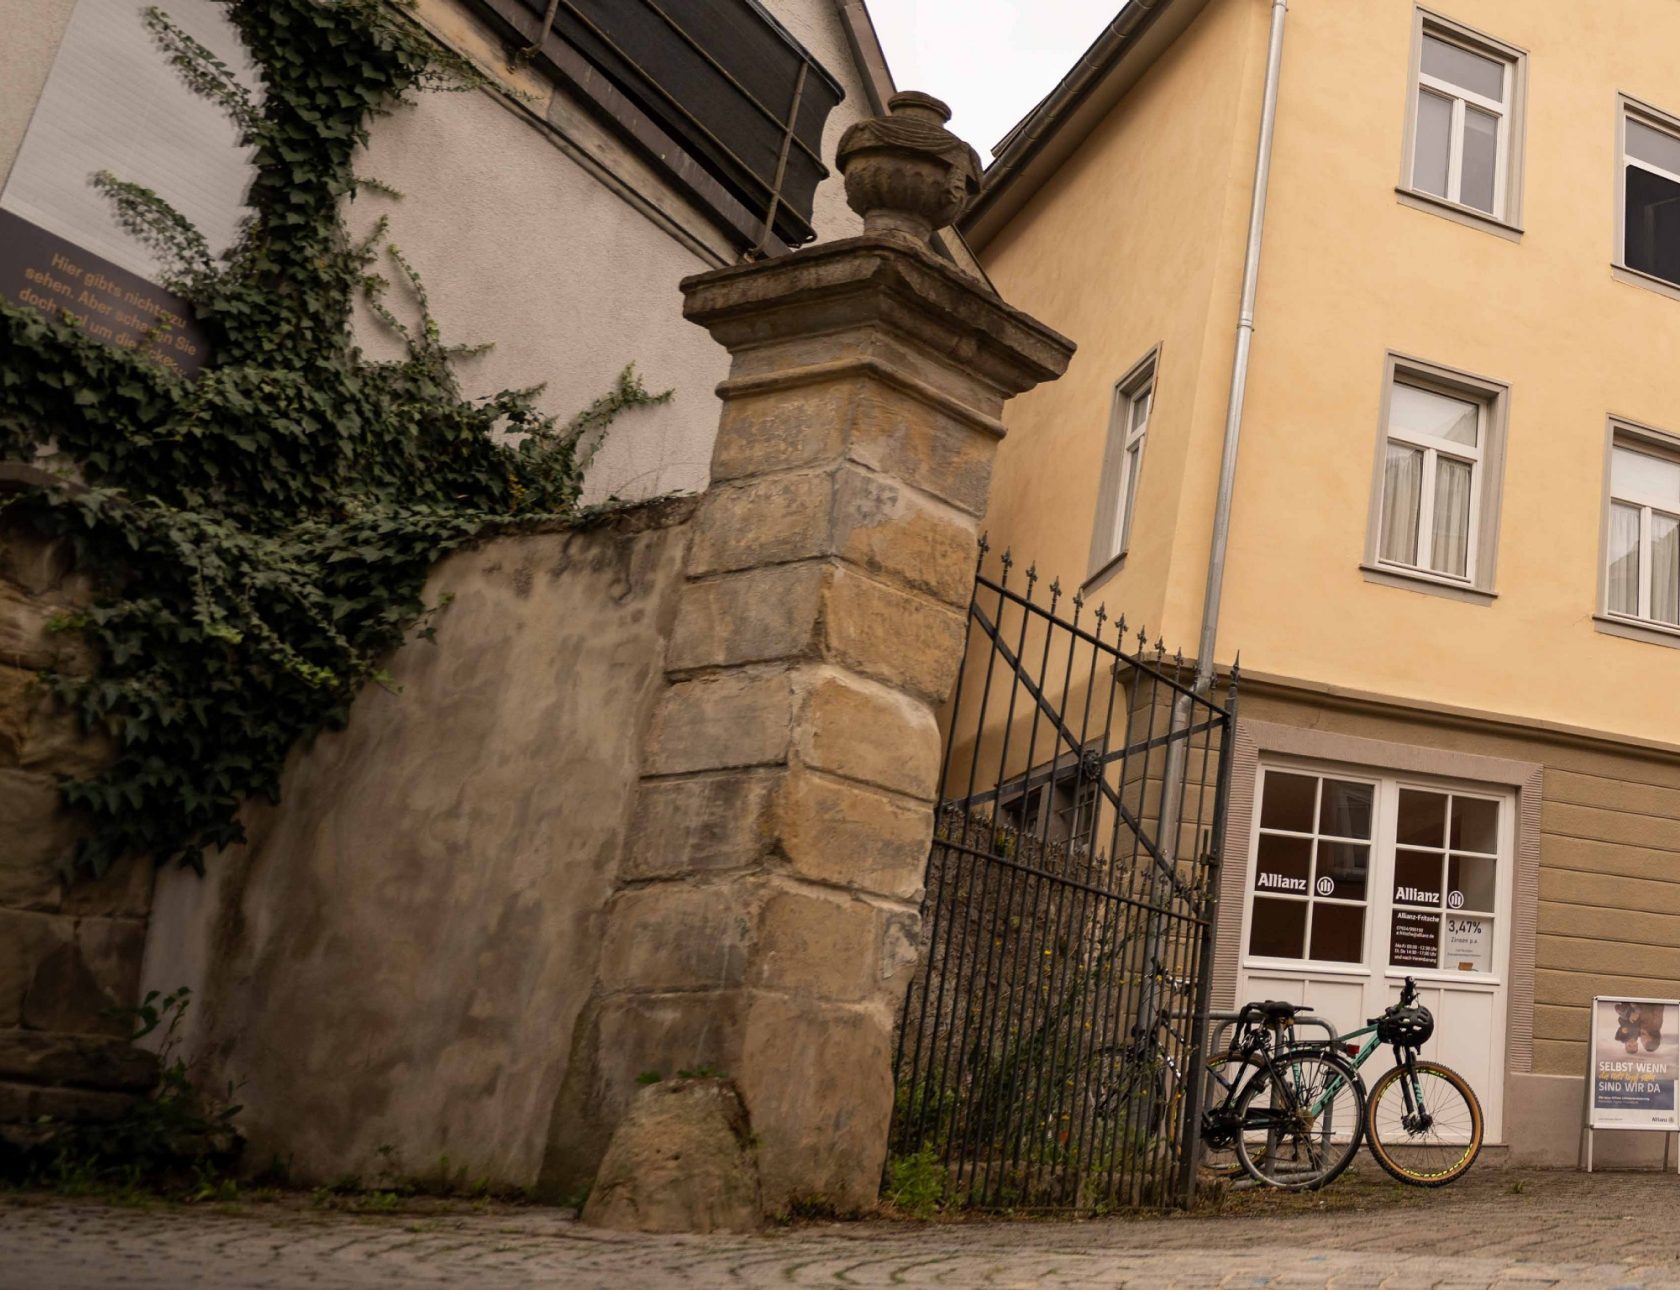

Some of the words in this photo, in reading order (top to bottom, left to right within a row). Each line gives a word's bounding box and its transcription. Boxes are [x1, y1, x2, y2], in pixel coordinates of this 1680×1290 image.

[52, 253, 84, 278] Hier
[84, 272, 122, 298] gibts
[169, 313, 188, 329] zu
[18, 287, 57, 315] doch
[89, 320, 113, 340] um
[115, 331, 138, 349] die
[24, 267, 75, 299] sehen.
[78, 290, 113, 315] Aber
[115, 310, 174, 345] schan
[175, 335, 198, 356] Sie
[1257, 872, 1307, 890] Allianz
[1395, 886, 1440, 904] Allianz
[1397, 912, 1440, 923] Allianz-Fritsche
[1448, 920, 1482, 935] 3,47%
[1599, 1061, 1634, 1073] SELBST
[1636, 1063, 1667, 1073] WENN
[1598, 1081, 1622, 1092] SIND
[1624, 1082, 1645, 1093] WIR
[1647, 1082, 1661, 1093] DA
